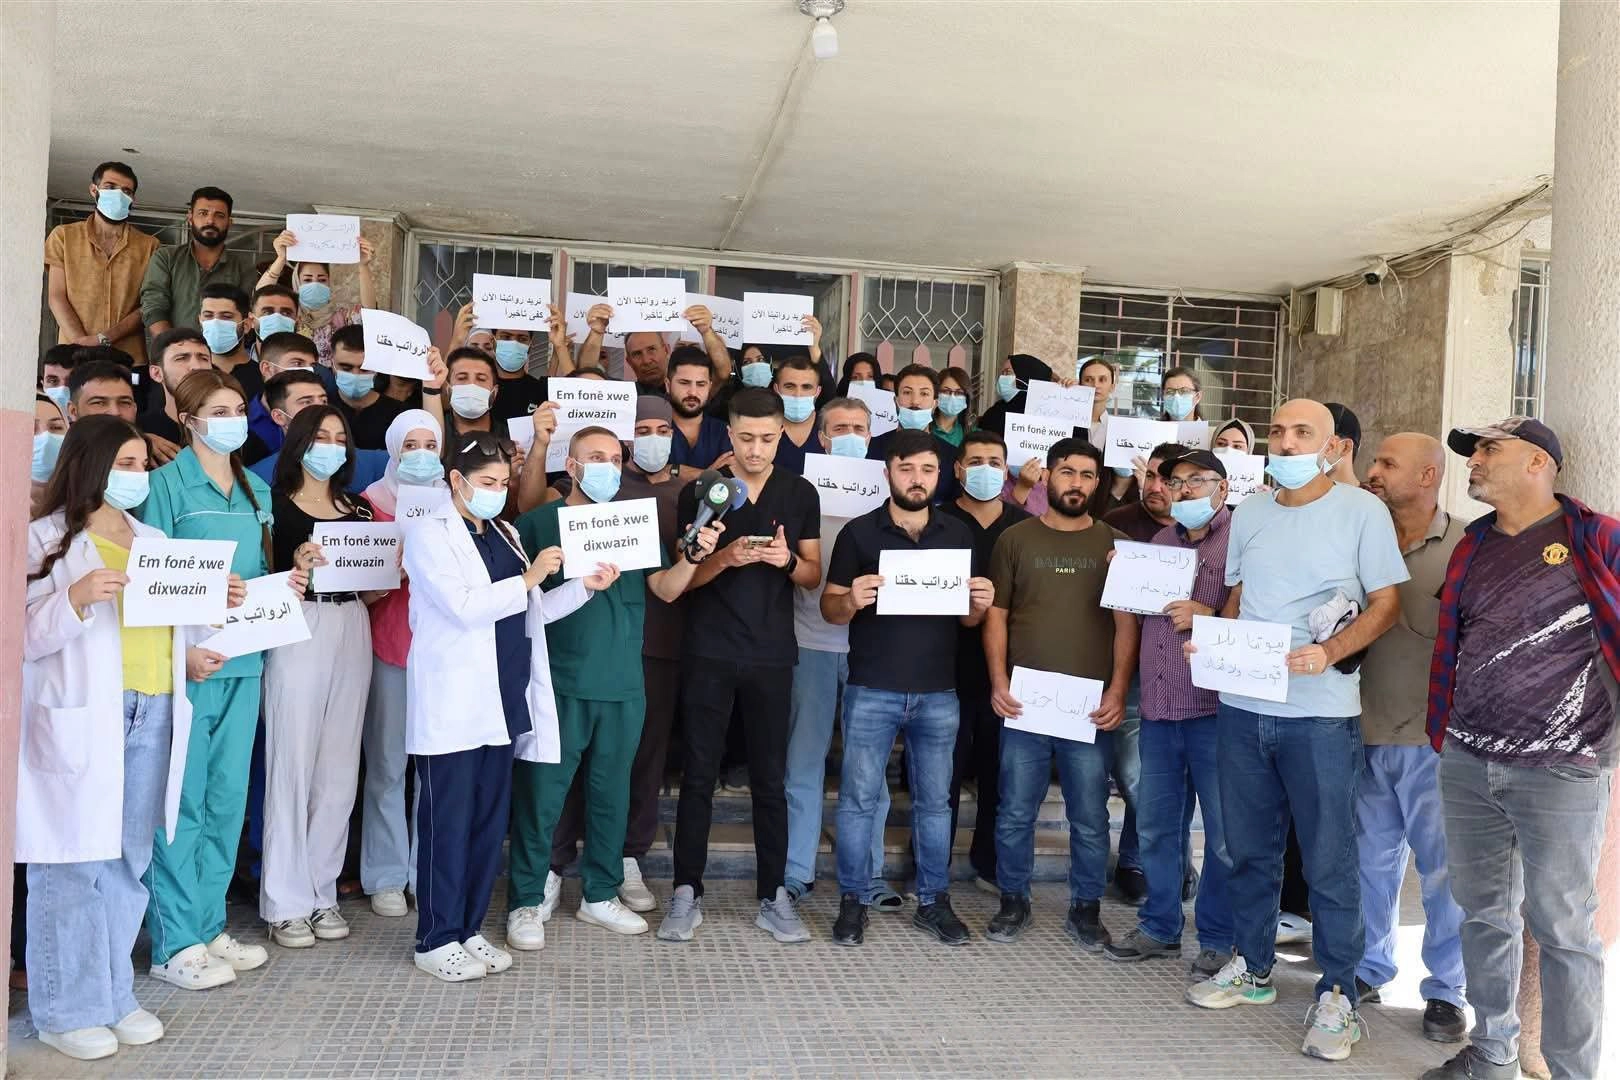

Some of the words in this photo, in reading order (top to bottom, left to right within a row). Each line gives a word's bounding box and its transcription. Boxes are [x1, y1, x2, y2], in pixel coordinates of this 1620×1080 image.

[500, 293, 524, 304] رواتبنا
[526, 297, 541, 305] نريد
[634, 296, 658, 306] رواتبنا
[661, 297, 676, 306] نريد
[529, 310, 544, 320] كفى
[665, 311, 680, 321] كفى
[377, 334, 393, 346] حقنا
[556, 390, 574, 400] Em
[578, 389, 604, 401] fonê
[606, 392, 630, 401] xwe
[567, 408, 617, 419] dixwazin
[1011, 423, 1025, 432] Em
[1028, 424, 1047, 435] fonê
[1048, 429, 1067, 438] xwe
[817, 477, 838, 489] حقنا
[842, 482, 880, 497] الرواتب
[568, 520, 588, 532] Em
[591, 514, 620, 528] fonê
[623, 514, 649, 525] xwe
[321, 535, 341, 546] Em
[344, 535, 370, 546] fonê
[373, 537, 397, 546] xwe
[583, 535, 639, 552] dixwazin
[138, 554, 160, 569] Em
[164, 554, 195, 570] fonê
[198, 558, 225, 570] xwe
[335, 556, 384, 568] dixwazin
[895, 574, 917, 585] حقنا
[921, 575, 962, 590] الرواتب
[148, 581, 207, 595] dixwazin
[244, 601, 291, 624] الرواتب
